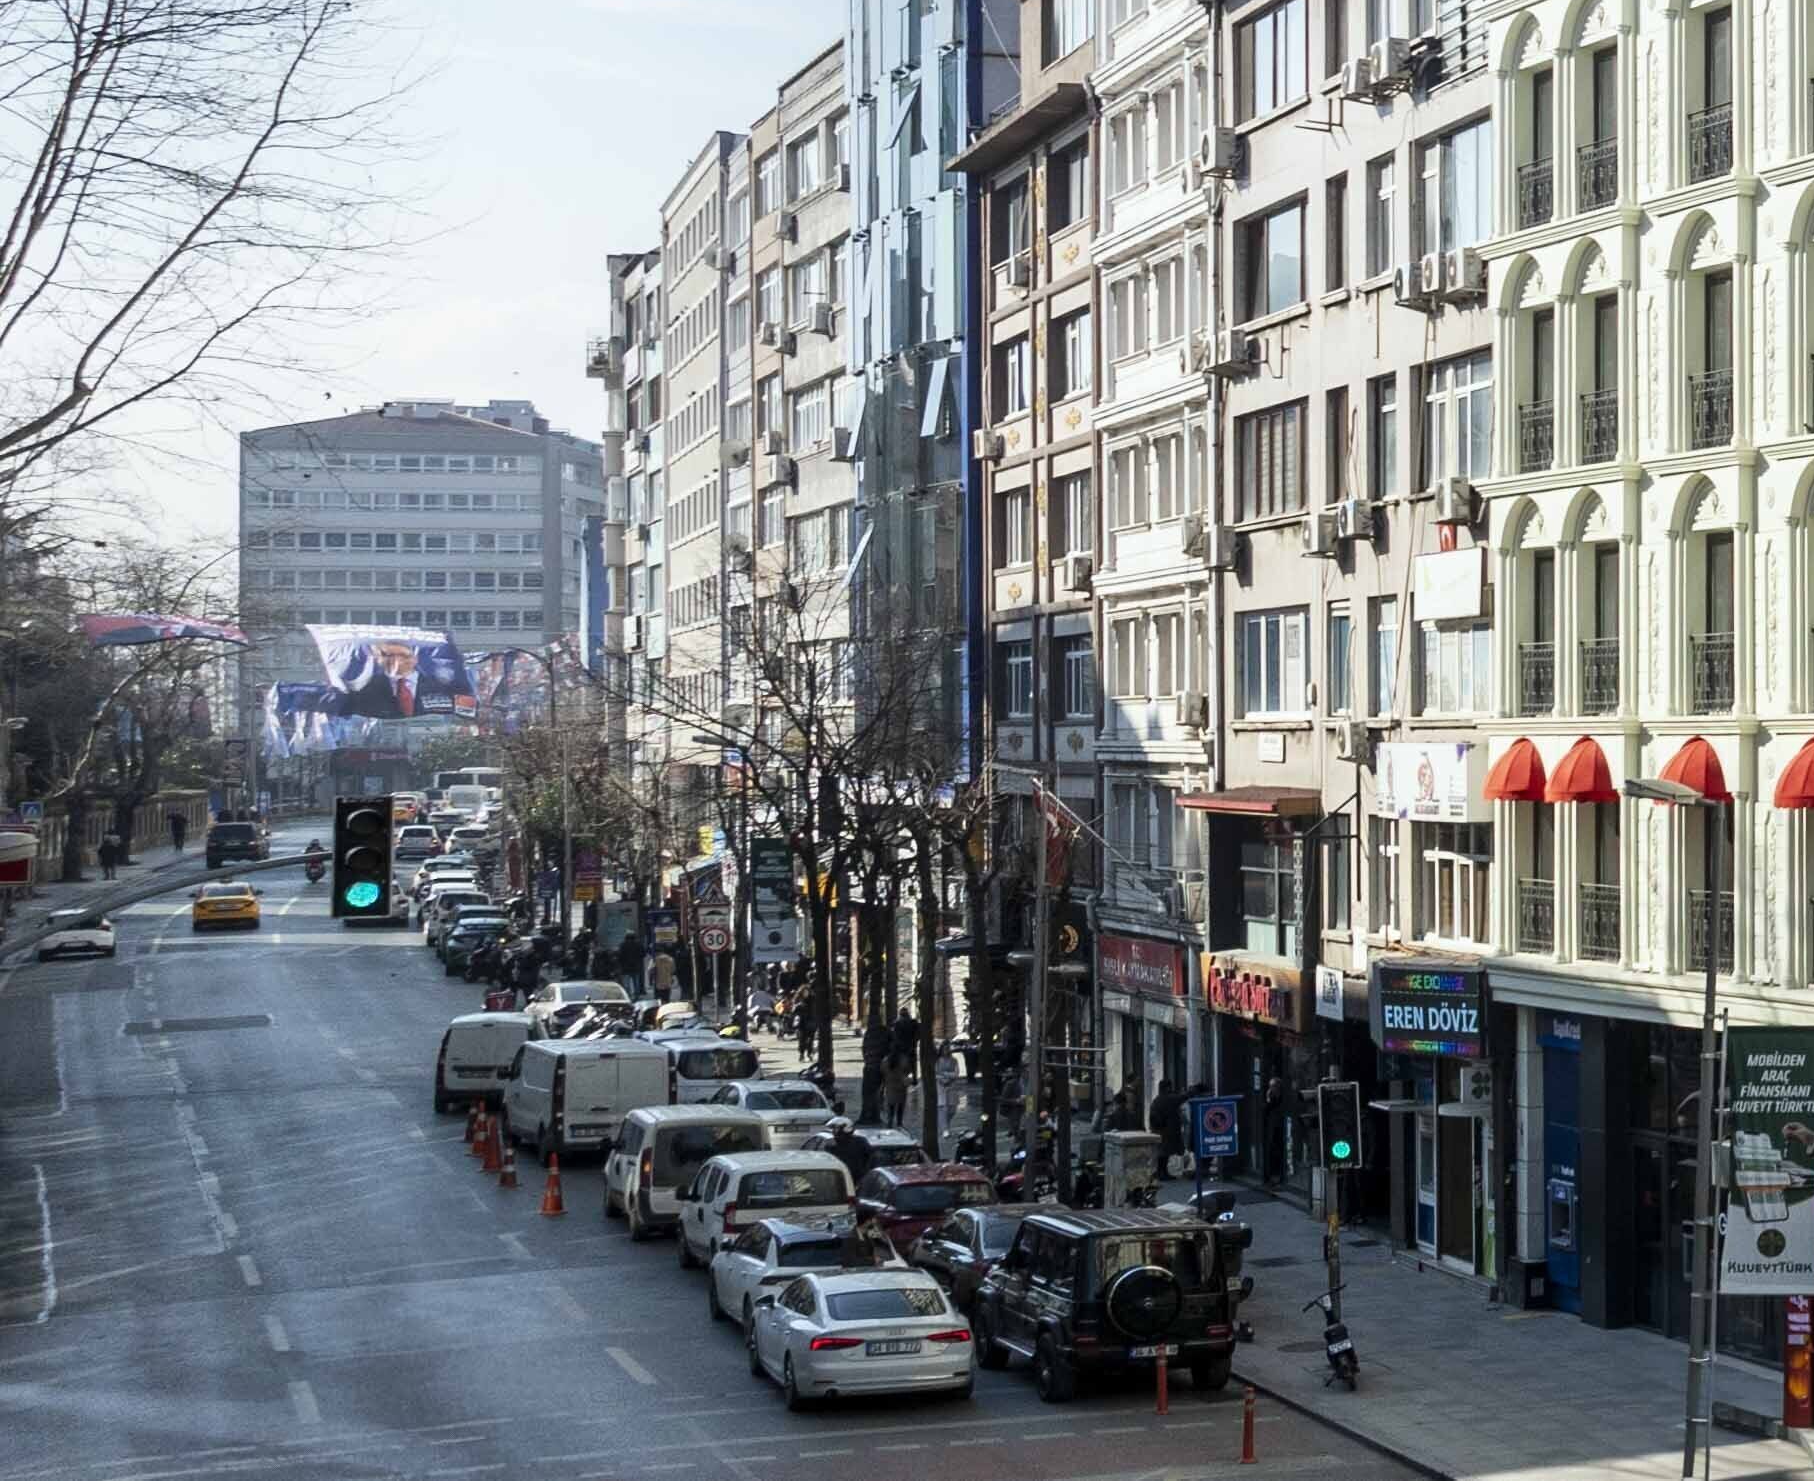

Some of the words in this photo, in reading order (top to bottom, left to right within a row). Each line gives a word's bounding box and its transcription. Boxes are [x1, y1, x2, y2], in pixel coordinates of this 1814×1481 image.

[706, 933, 724, 947] 30
[1384, 1005, 1424, 1030] EREN
[1428, 1002, 1479, 1033] DÖVİZ
[1747, 1050, 1806, 1067] MOBİLDEN
[1760, 1069, 1792, 1085] ARAÇ
[1740, 1082, 1811, 1098] FİNANSMANI
[1731, 1100, 1774, 1114] KUVEYT
